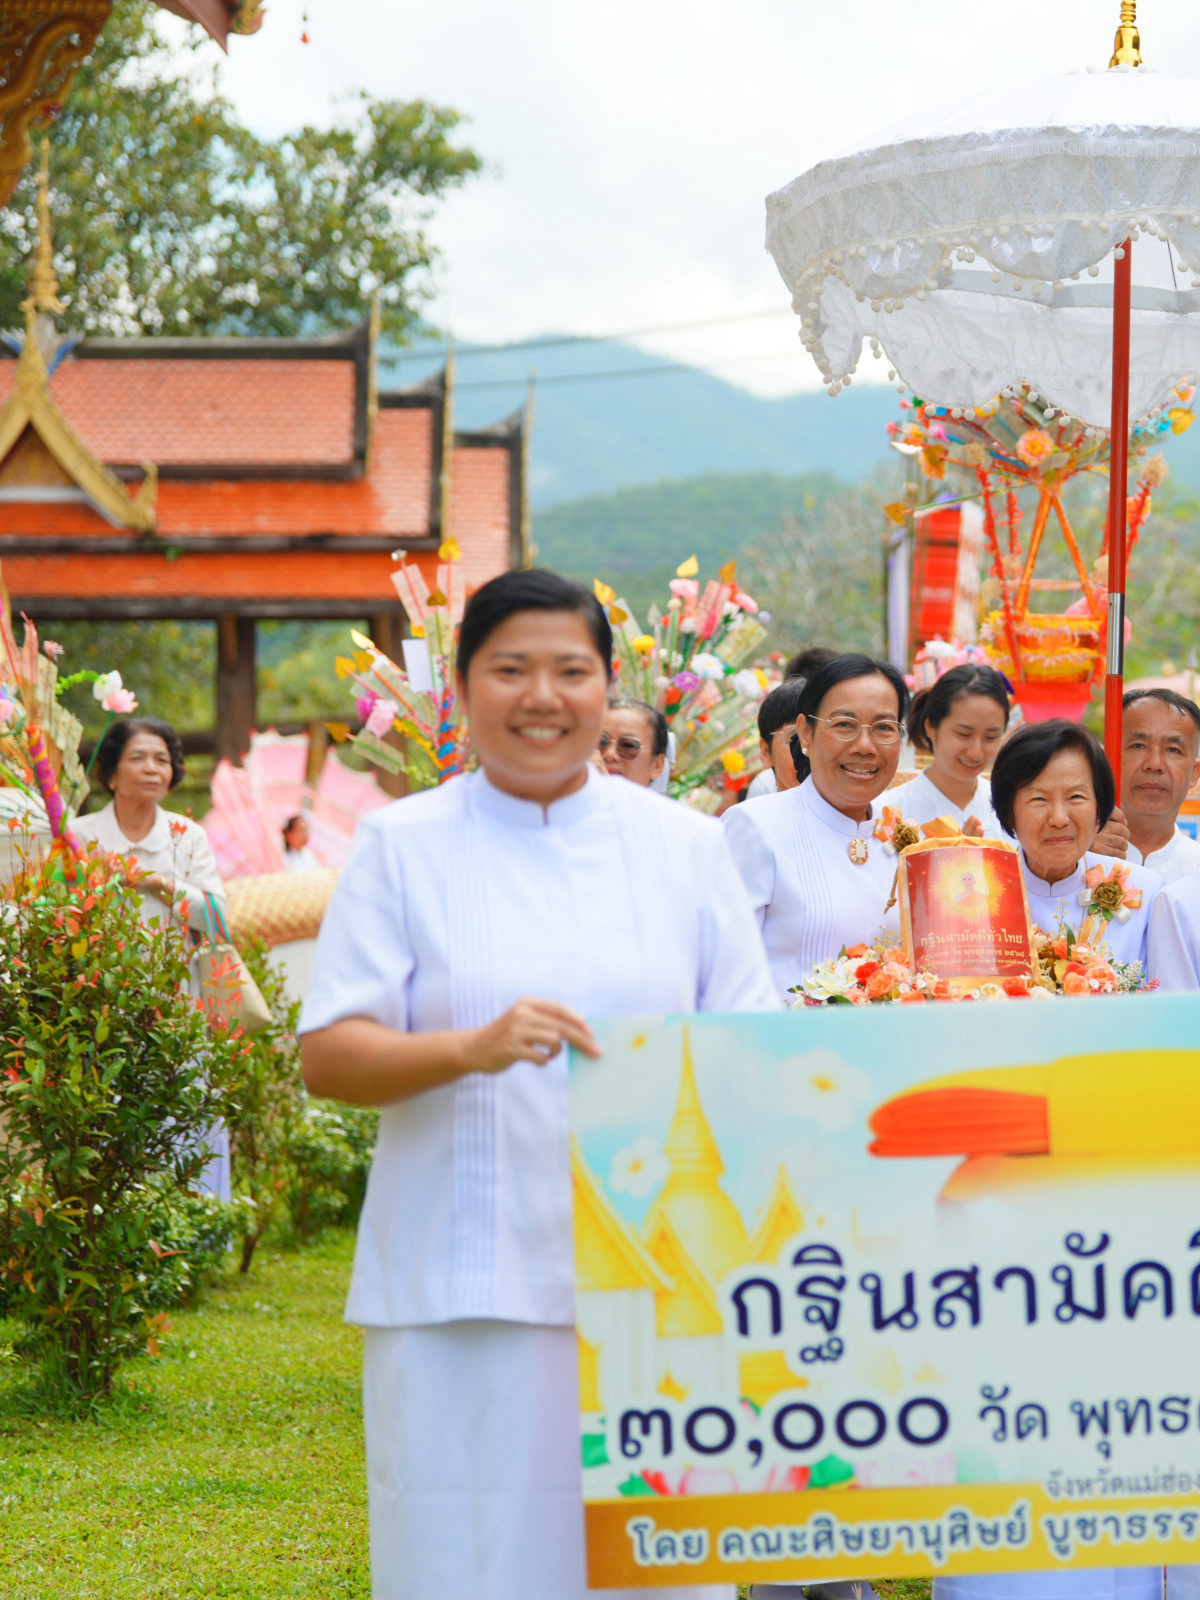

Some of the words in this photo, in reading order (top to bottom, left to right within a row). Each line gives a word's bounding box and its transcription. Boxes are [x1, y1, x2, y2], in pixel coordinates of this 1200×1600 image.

[920, 926, 1023, 948] กฐินสามัคคีทั่วไทย
[619, 1397, 950, 1467] ๓๐,๐๐๐
[979, 1384, 1048, 1443] วัด
[633, 1524, 702, 1560] โดย
[722, 1505, 1027, 1561] คณะศิษยานุศิษย์
